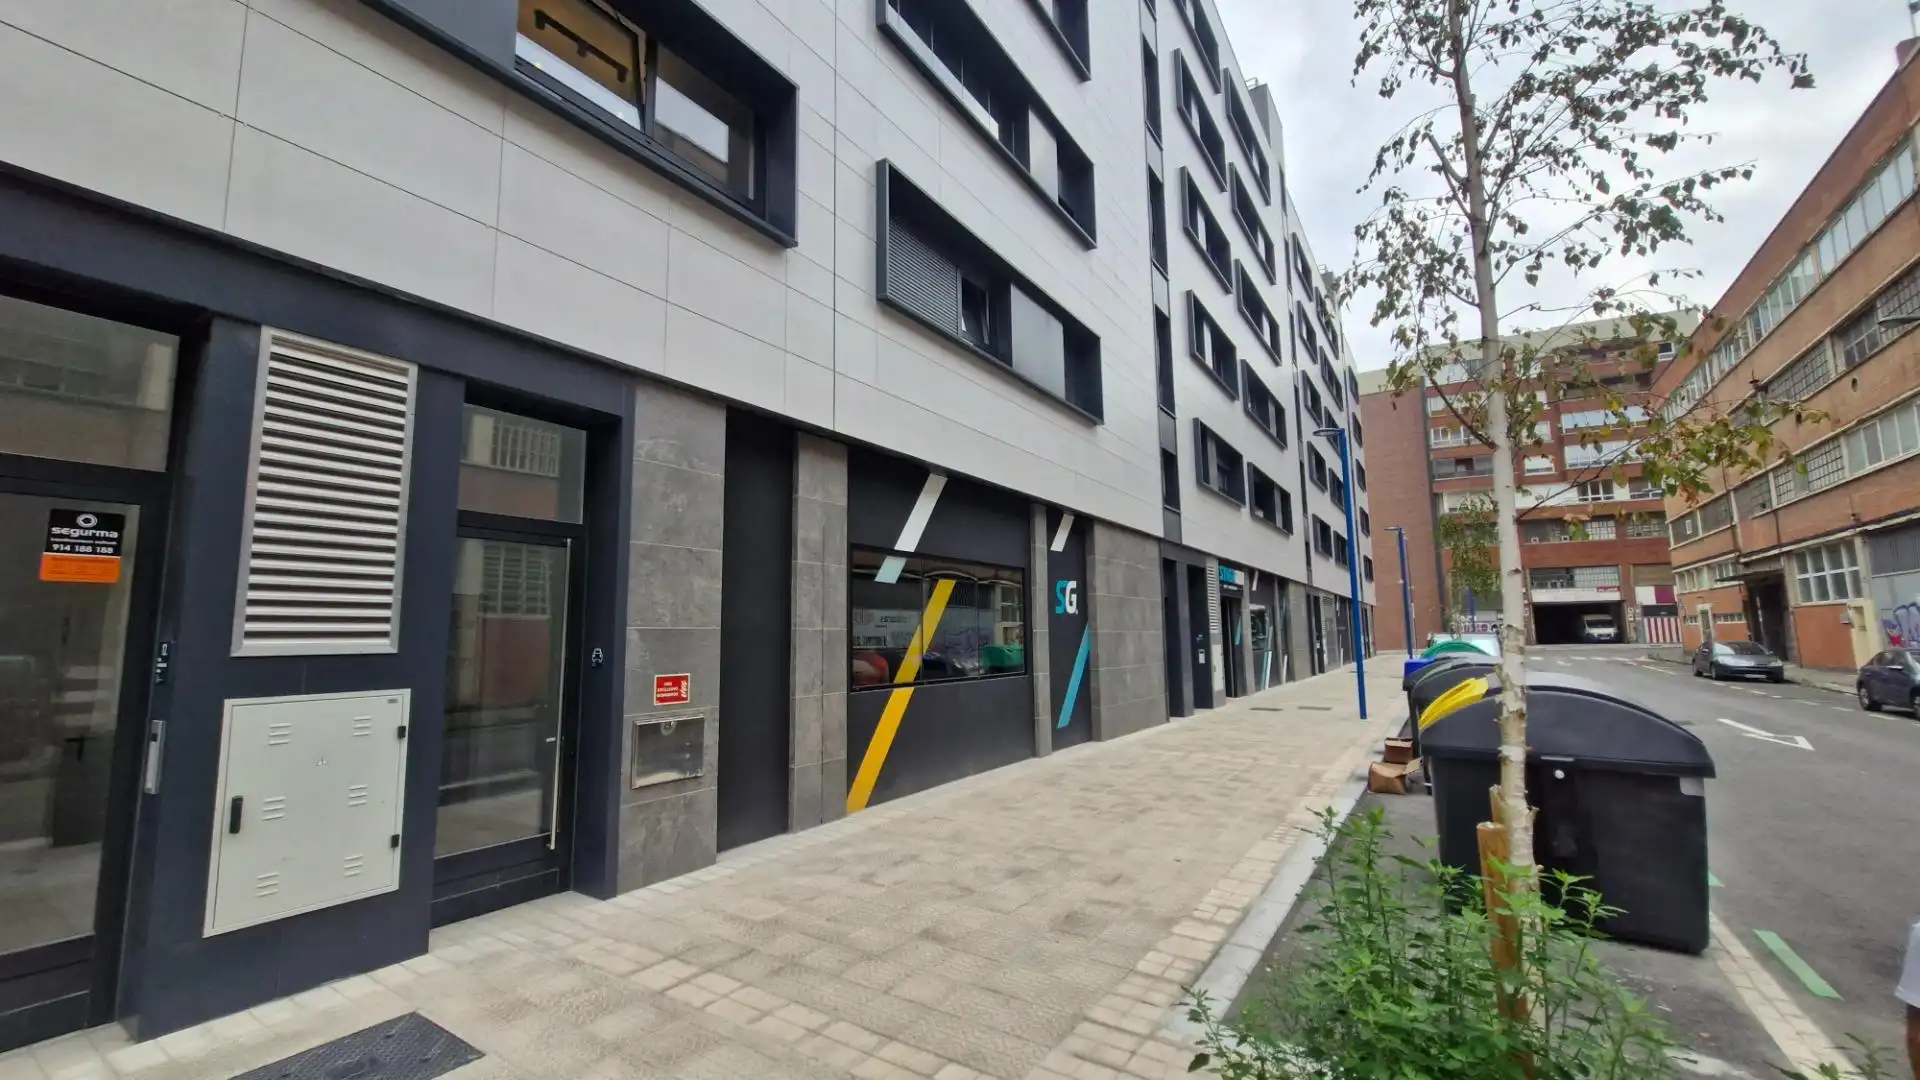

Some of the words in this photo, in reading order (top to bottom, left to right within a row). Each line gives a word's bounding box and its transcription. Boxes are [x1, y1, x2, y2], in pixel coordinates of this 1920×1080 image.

[51, 527, 118, 538] segurma
[52, 543, 71, 552] 914
[1055, 579, 1077, 614] SG
